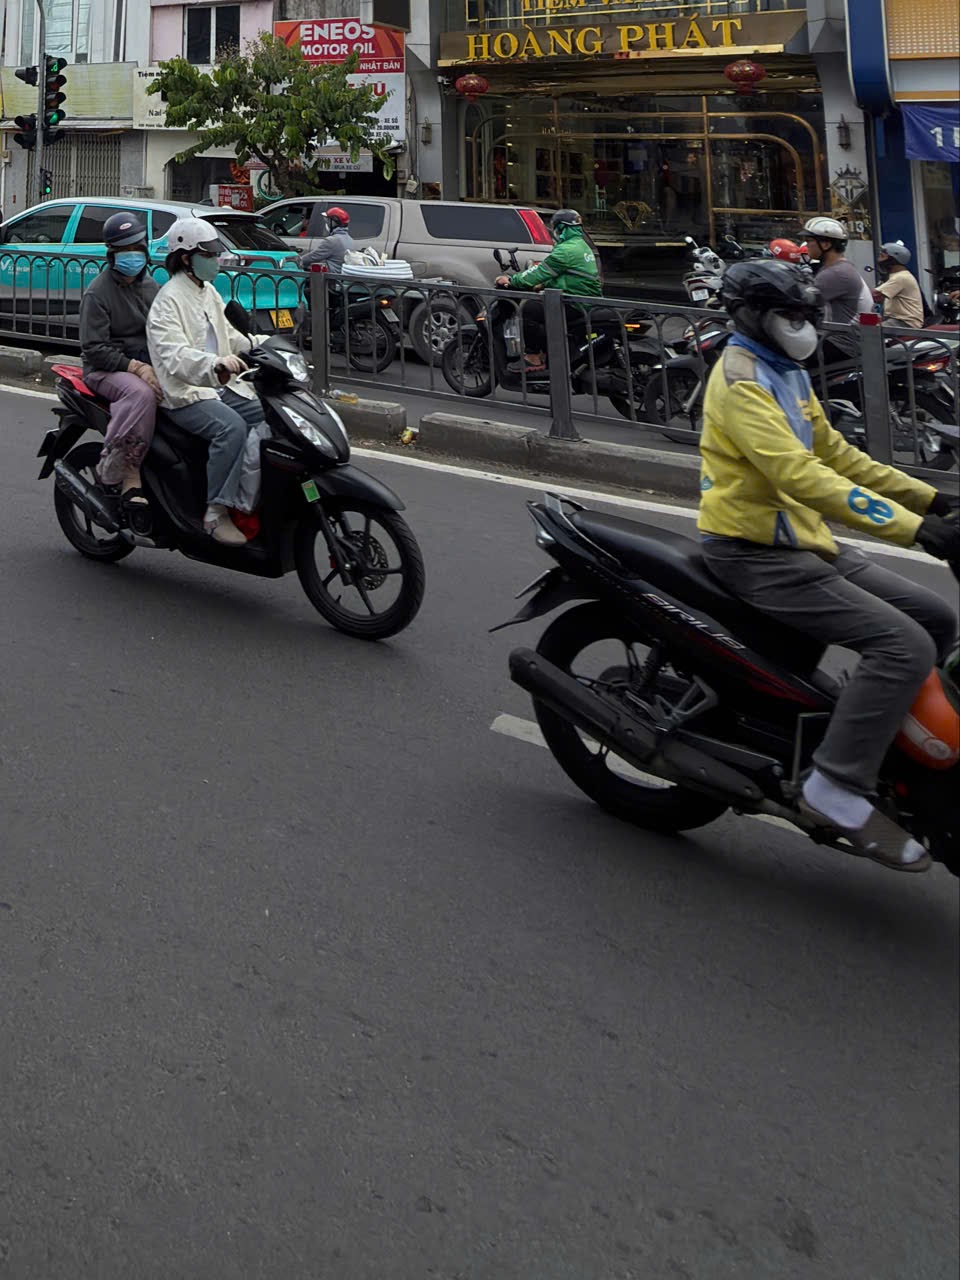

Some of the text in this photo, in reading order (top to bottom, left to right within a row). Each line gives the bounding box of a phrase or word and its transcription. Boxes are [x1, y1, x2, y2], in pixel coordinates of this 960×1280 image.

[300, 21, 376, 41] ENEOS
[466, 11, 742, 60] HOÀNG PHÁT
[301, 42, 375, 56] MOTOR OIL
[360, 61, 382, 72] NHẬT
